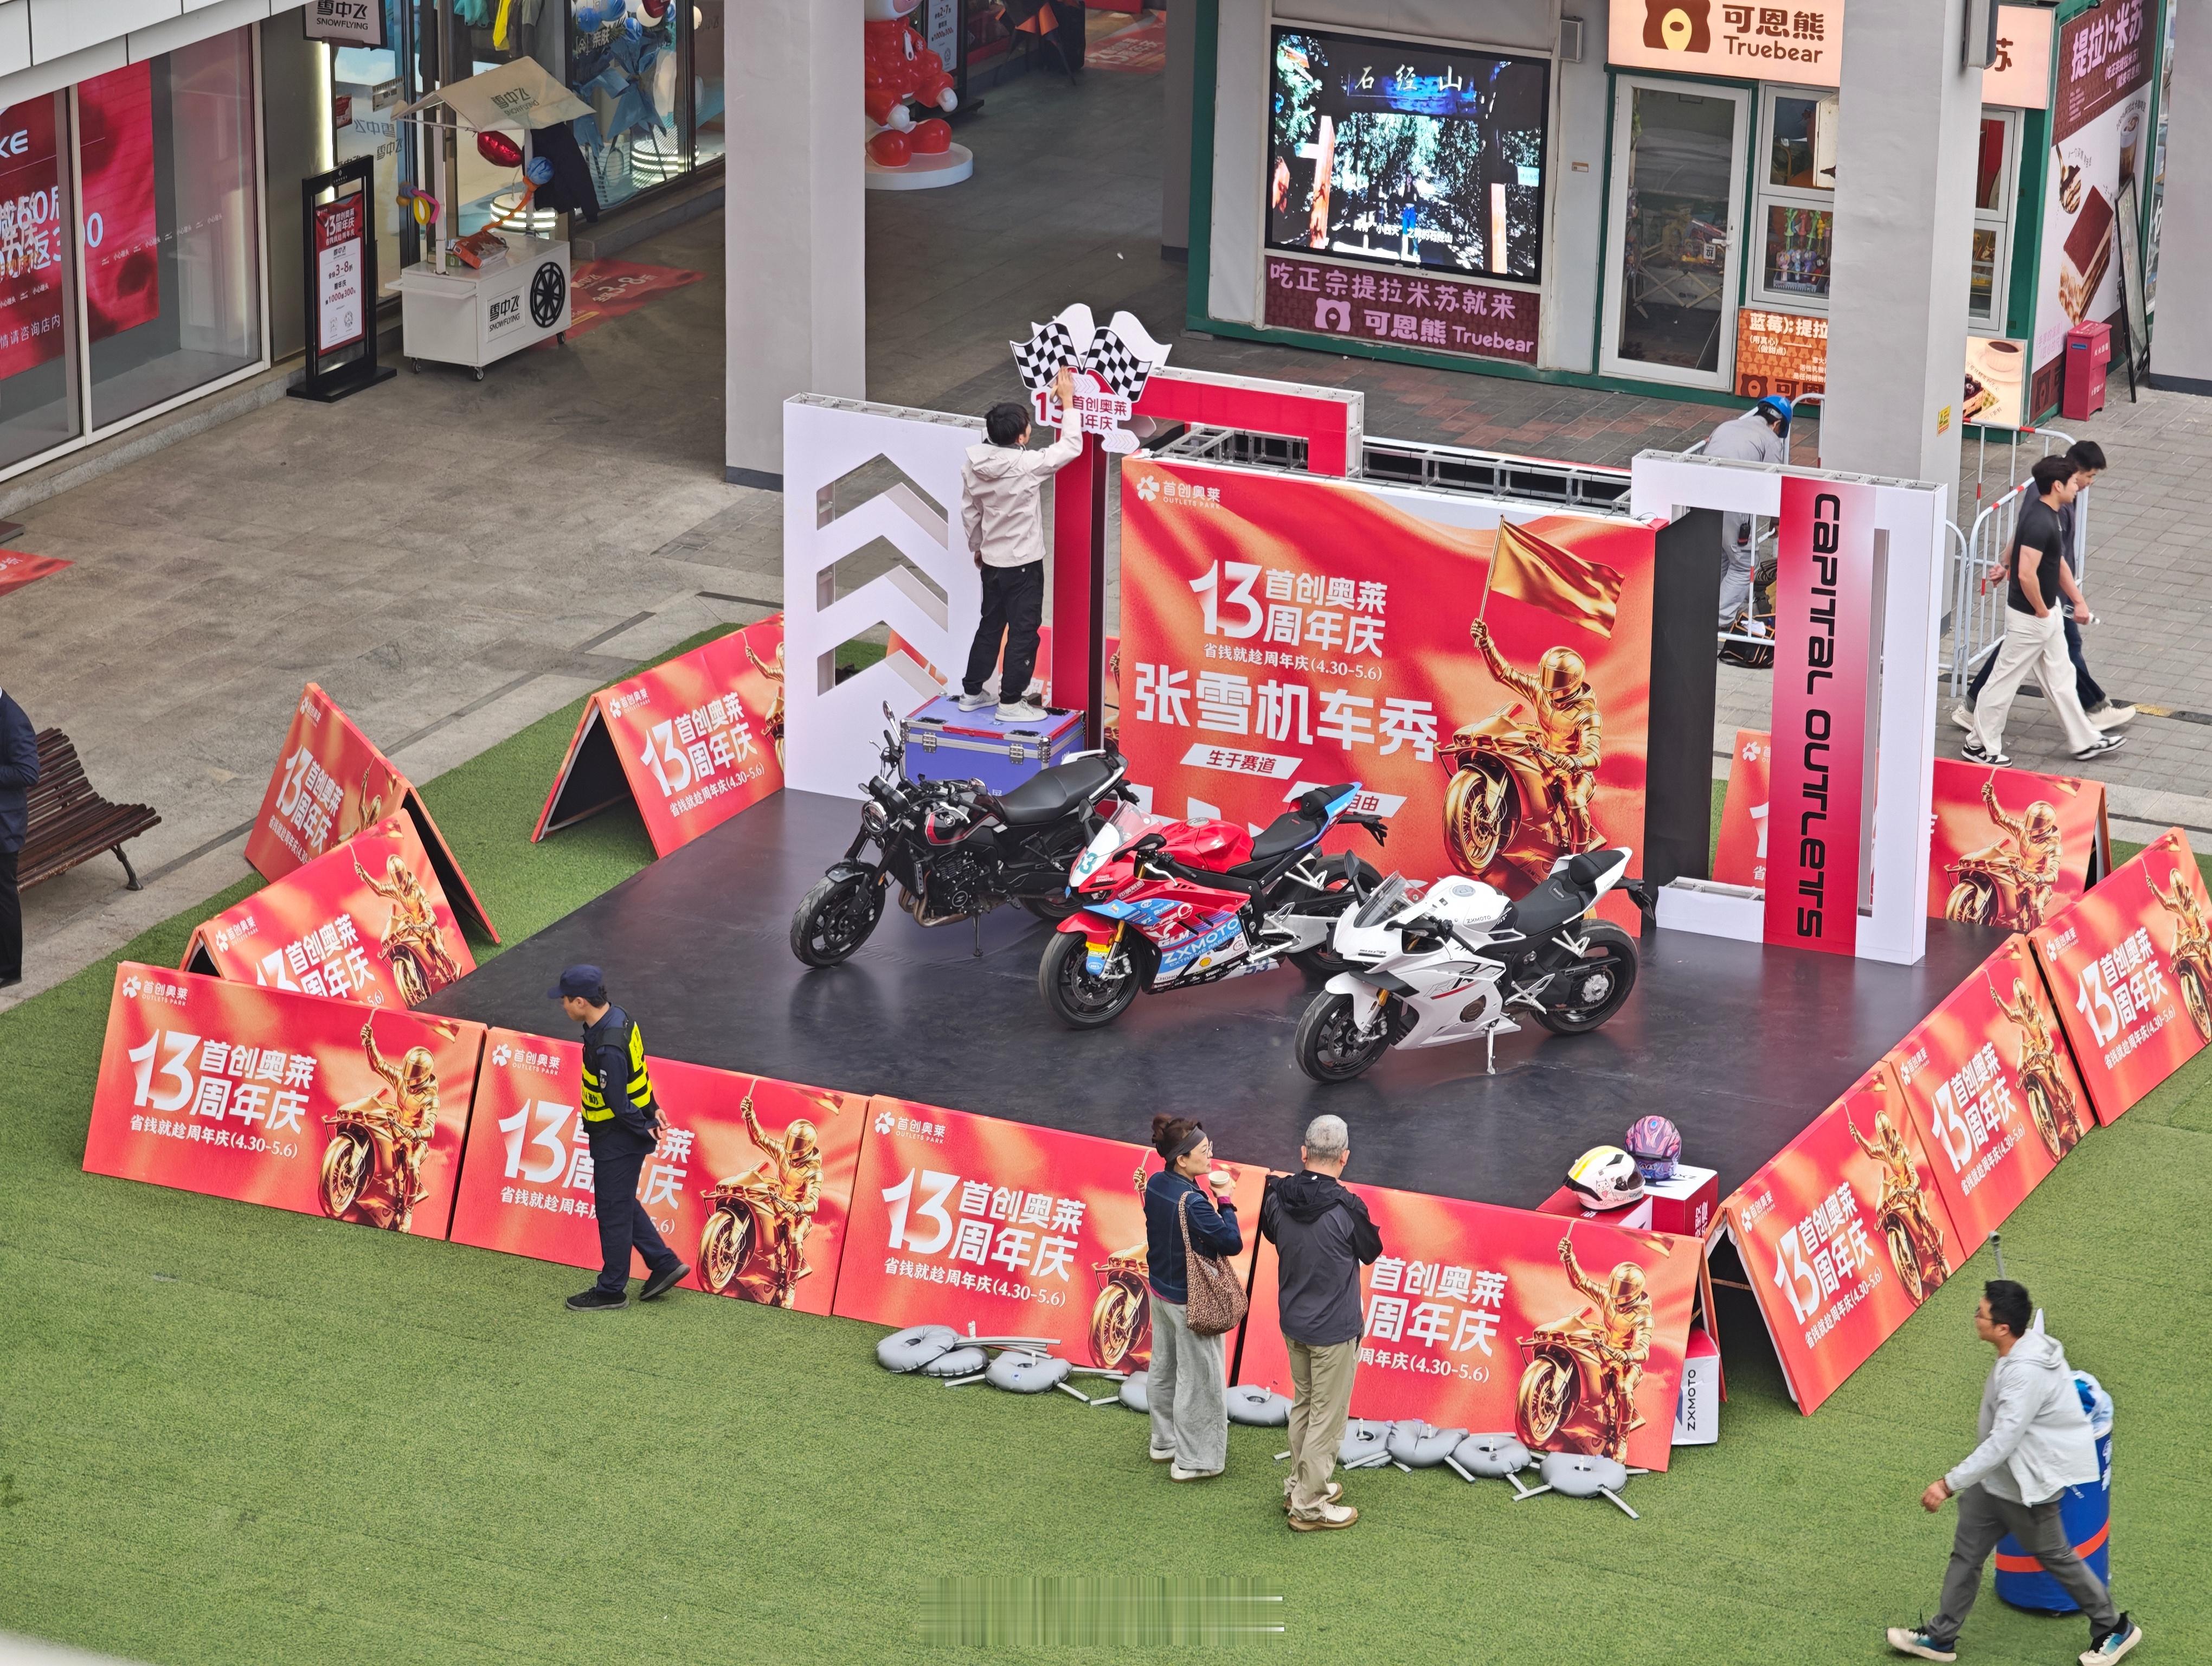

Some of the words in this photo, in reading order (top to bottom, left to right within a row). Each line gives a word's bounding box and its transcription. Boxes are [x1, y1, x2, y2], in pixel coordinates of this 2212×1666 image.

[317, 0, 367, 19] 雪中飞
[317, 18, 368, 30] SNOWFLYING
[1722, 4, 1824, 41] 可恩熊
[1724, 35, 1823, 63] Truebear
[1995, 38, 2014, 72] 苏
[491, 87, 531, 108] 雪中飞
[1354, 63, 1463, 91] 石经山
[376, 137, 404, 161] 雪中飞
[490, 294, 519, 322] 雪中飞
[1270, 263, 1516, 320] 吃正宗提拉米苏就来
[489, 313, 520, 332] SNOWFLYING
[1364, 309, 1446, 344] 可恩熊
[1451, 325, 1534, 354] Truebear
[1792, 372, 1825, 383] 是任何植物
[1799, 364, 1826, 373] 活性乳酸
[1072, 395, 1127, 416] 首创奥莱
[1163, 481, 1220, 503] 首创奥莱
[1163, 497, 1197, 507] OUTLETS
[1200, 502, 1220, 510] PARK
[1189, 559, 1263, 639] 13
[1265, 568, 1388, 614] 首创奥莱
[1263, 604, 1386, 658] 周年庆
[1203, 643, 1383, 682] 省钱就趁周年庆(4.30-5.6)
[675, 691, 745, 745] 首创奥莱
[1135, 662, 1437, 762] 张雪机车秀
[640, 719, 692, 798] 13
[687, 722, 758, 781] 周年庆
[1206, 749, 1277, 774] 生于赛道
[275, 744, 313, 816] 13
[304, 760, 344, 817] 首创奥莱
[670, 761, 765, 818] 省钱就趁周年庆(4.30-5.6)
[290, 790, 333, 854] 周年庆
[285, 913, 359, 975] 首创奥莱
[1164, 919, 1239, 964] ZXMOTO
[1467, 915, 1491, 924] ZXMOTO
[301, 946, 376, 999] 周年庆
[2100, 926, 2155, 987] 首创奥莱
[143, 980, 188, 1001] 首创奥莱
[2075, 959, 2119, 1049] 13
[2112, 959, 2169, 1031] 周年庆
[201, 1039, 318, 1090] 首创奥莱
[513, 1049, 561, 1069] 首创奥莱
[2104, 1004, 2176, 1071] 省钱就趁周年庆(4.30-5.6)
[128, 1028, 202, 1112] 13
[1950, 1041, 2002, 1106] 首创奥莱
[189, 1076, 310, 1135] 周年庆
[897, 1116, 946, 1138] 首创奥莱
[1931, 1080, 1974, 1175] 13
[1963, 1075, 2017, 1151] 周年庆
[130, 1114, 298, 1159] 省钱就趁周年庆(4.30-5.6)
[498, 1098, 575, 1183] 13
[896, 1130, 923, 1140] OUTLETS
[1960, 1123, 2025, 1197] 省钱就趁周年庆(4.30-5.6)
[882, 1167, 961, 1254] 13
[959, 1180, 1086, 1235] 首创奥莱
[1749, 1190, 1774, 1219] 首创奥莱
[1798, 1181, 1858, 1253] 首创奥莱
[948, 1218, 1079, 1283] 周年庆
[1774, 1225, 1821, 1325] 13
[1812, 1216, 1875, 1301] 周年庆
[884, 1256, 1066, 1308] 省钱就趁周年庆(4.30-5.6)
[1368, 1254, 1509, 1309] 首创奥莱
[1804, 1265, 1883, 1350] 省钱就趁周年庆(4.30-5.6)
[1364, 1293, 1502, 1358] 周年庆
[1358, 1348, 1490, 1385] 周年庆(4.30-5.6)
[1687, 1369, 1696, 1432] ZXMOTO
